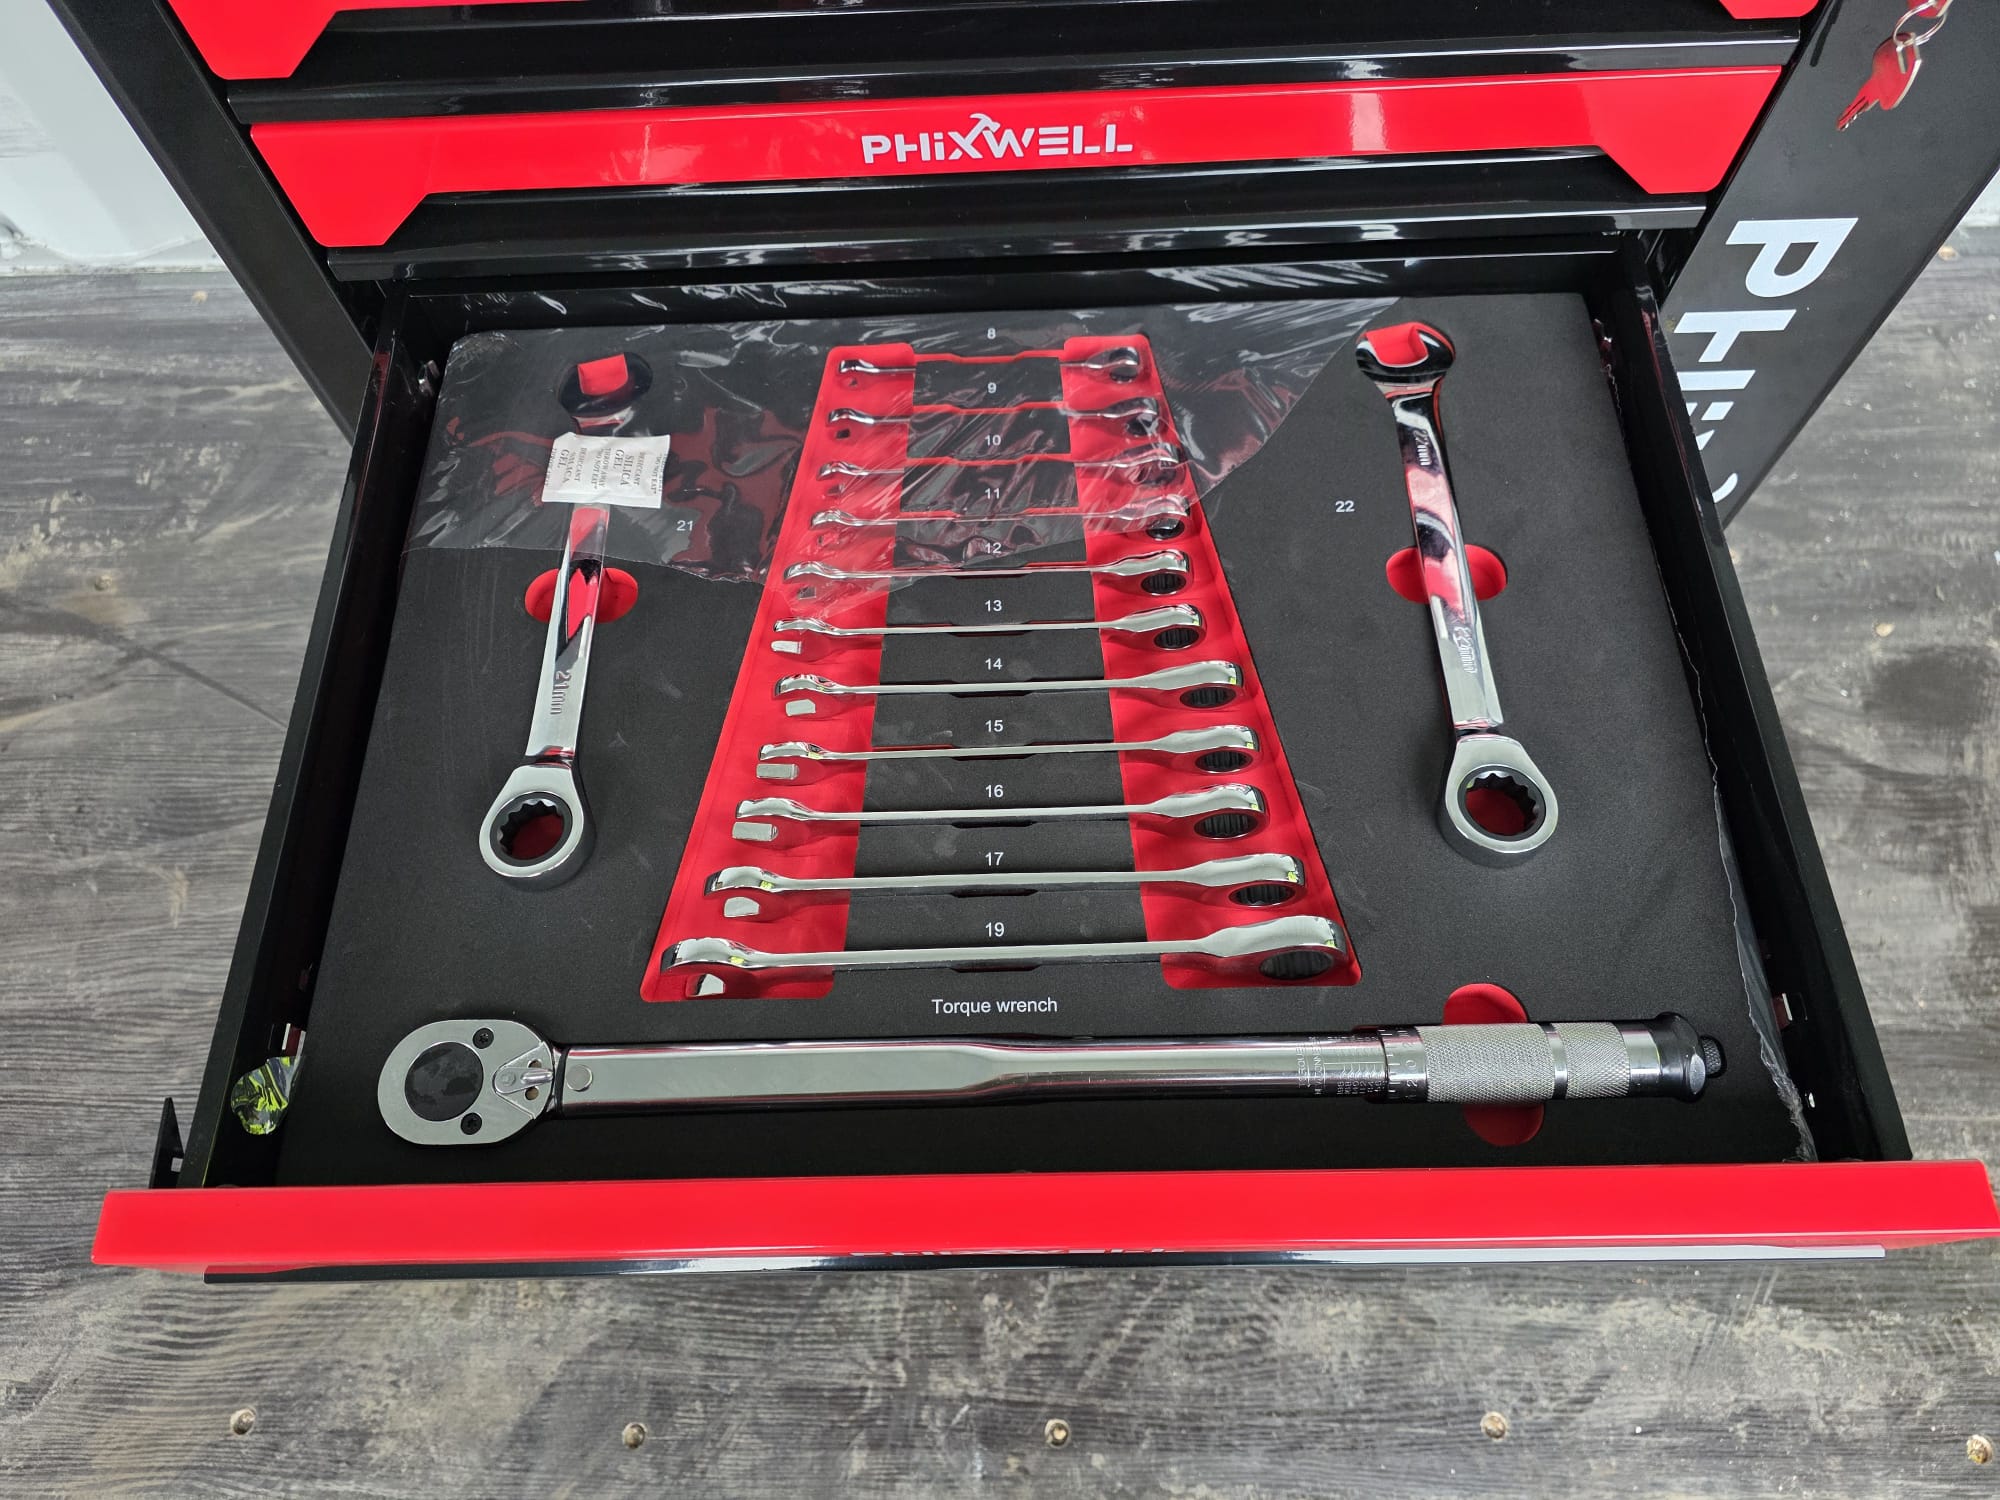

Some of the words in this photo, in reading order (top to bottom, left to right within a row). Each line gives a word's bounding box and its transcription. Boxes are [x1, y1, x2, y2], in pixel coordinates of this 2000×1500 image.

[986, 327, 997, 340] 8
[987, 381, 997, 394] 9
[984, 434, 1002, 447] 10
[557, 449, 569, 468] GEL
[601, 448, 611, 470] THROW
[613, 449, 625, 469] GEL
[620, 455, 635, 486] SILICA
[984, 488, 1001, 500] 11
[1334, 500, 1356, 513] 22
[675, 519, 694, 532] 21
[984, 542, 1002, 555] 12
[984, 599, 1003, 612] 13
[985, 657, 1003, 671] 14
[550, 670, 572, 715] 21mm
[985, 719, 1004, 733] 15
[985, 784, 1004, 798] 16
[985, 851, 1005, 866] 17
[985, 921, 1005, 938] 19
[931, 999, 992, 1017] Torque
[996, 997, 1058, 1013] wrench
